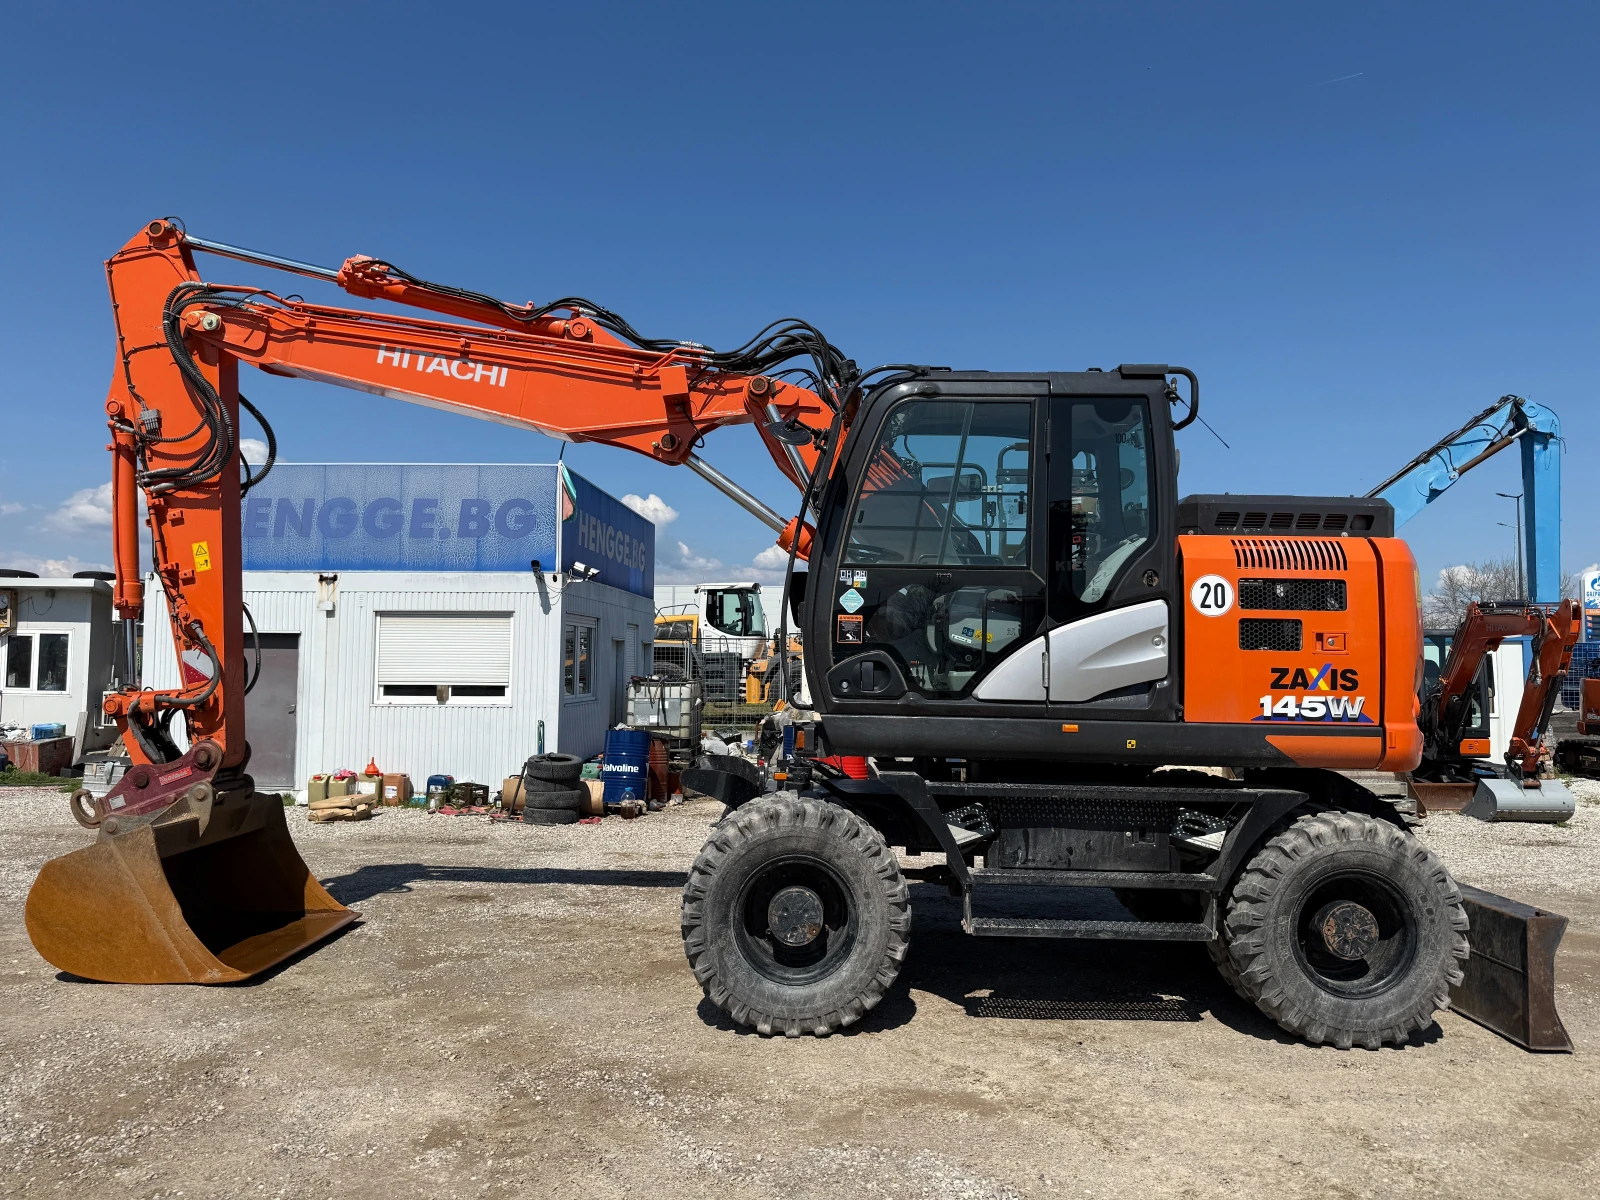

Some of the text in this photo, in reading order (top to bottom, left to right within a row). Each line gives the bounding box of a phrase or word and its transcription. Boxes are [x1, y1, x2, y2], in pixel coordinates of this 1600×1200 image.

[376, 344, 508, 388] HITACHI
[242, 497, 537, 540] ENGGE.BG
[578, 510, 646, 572] HENGGE.BG
[1200, 583, 1225, 608] 20
[1485, 622, 1517, 632] HITACHI
[1270, 663, 1359, 692] ZAXIS
[1260, 695, 1365, 721] 145W
